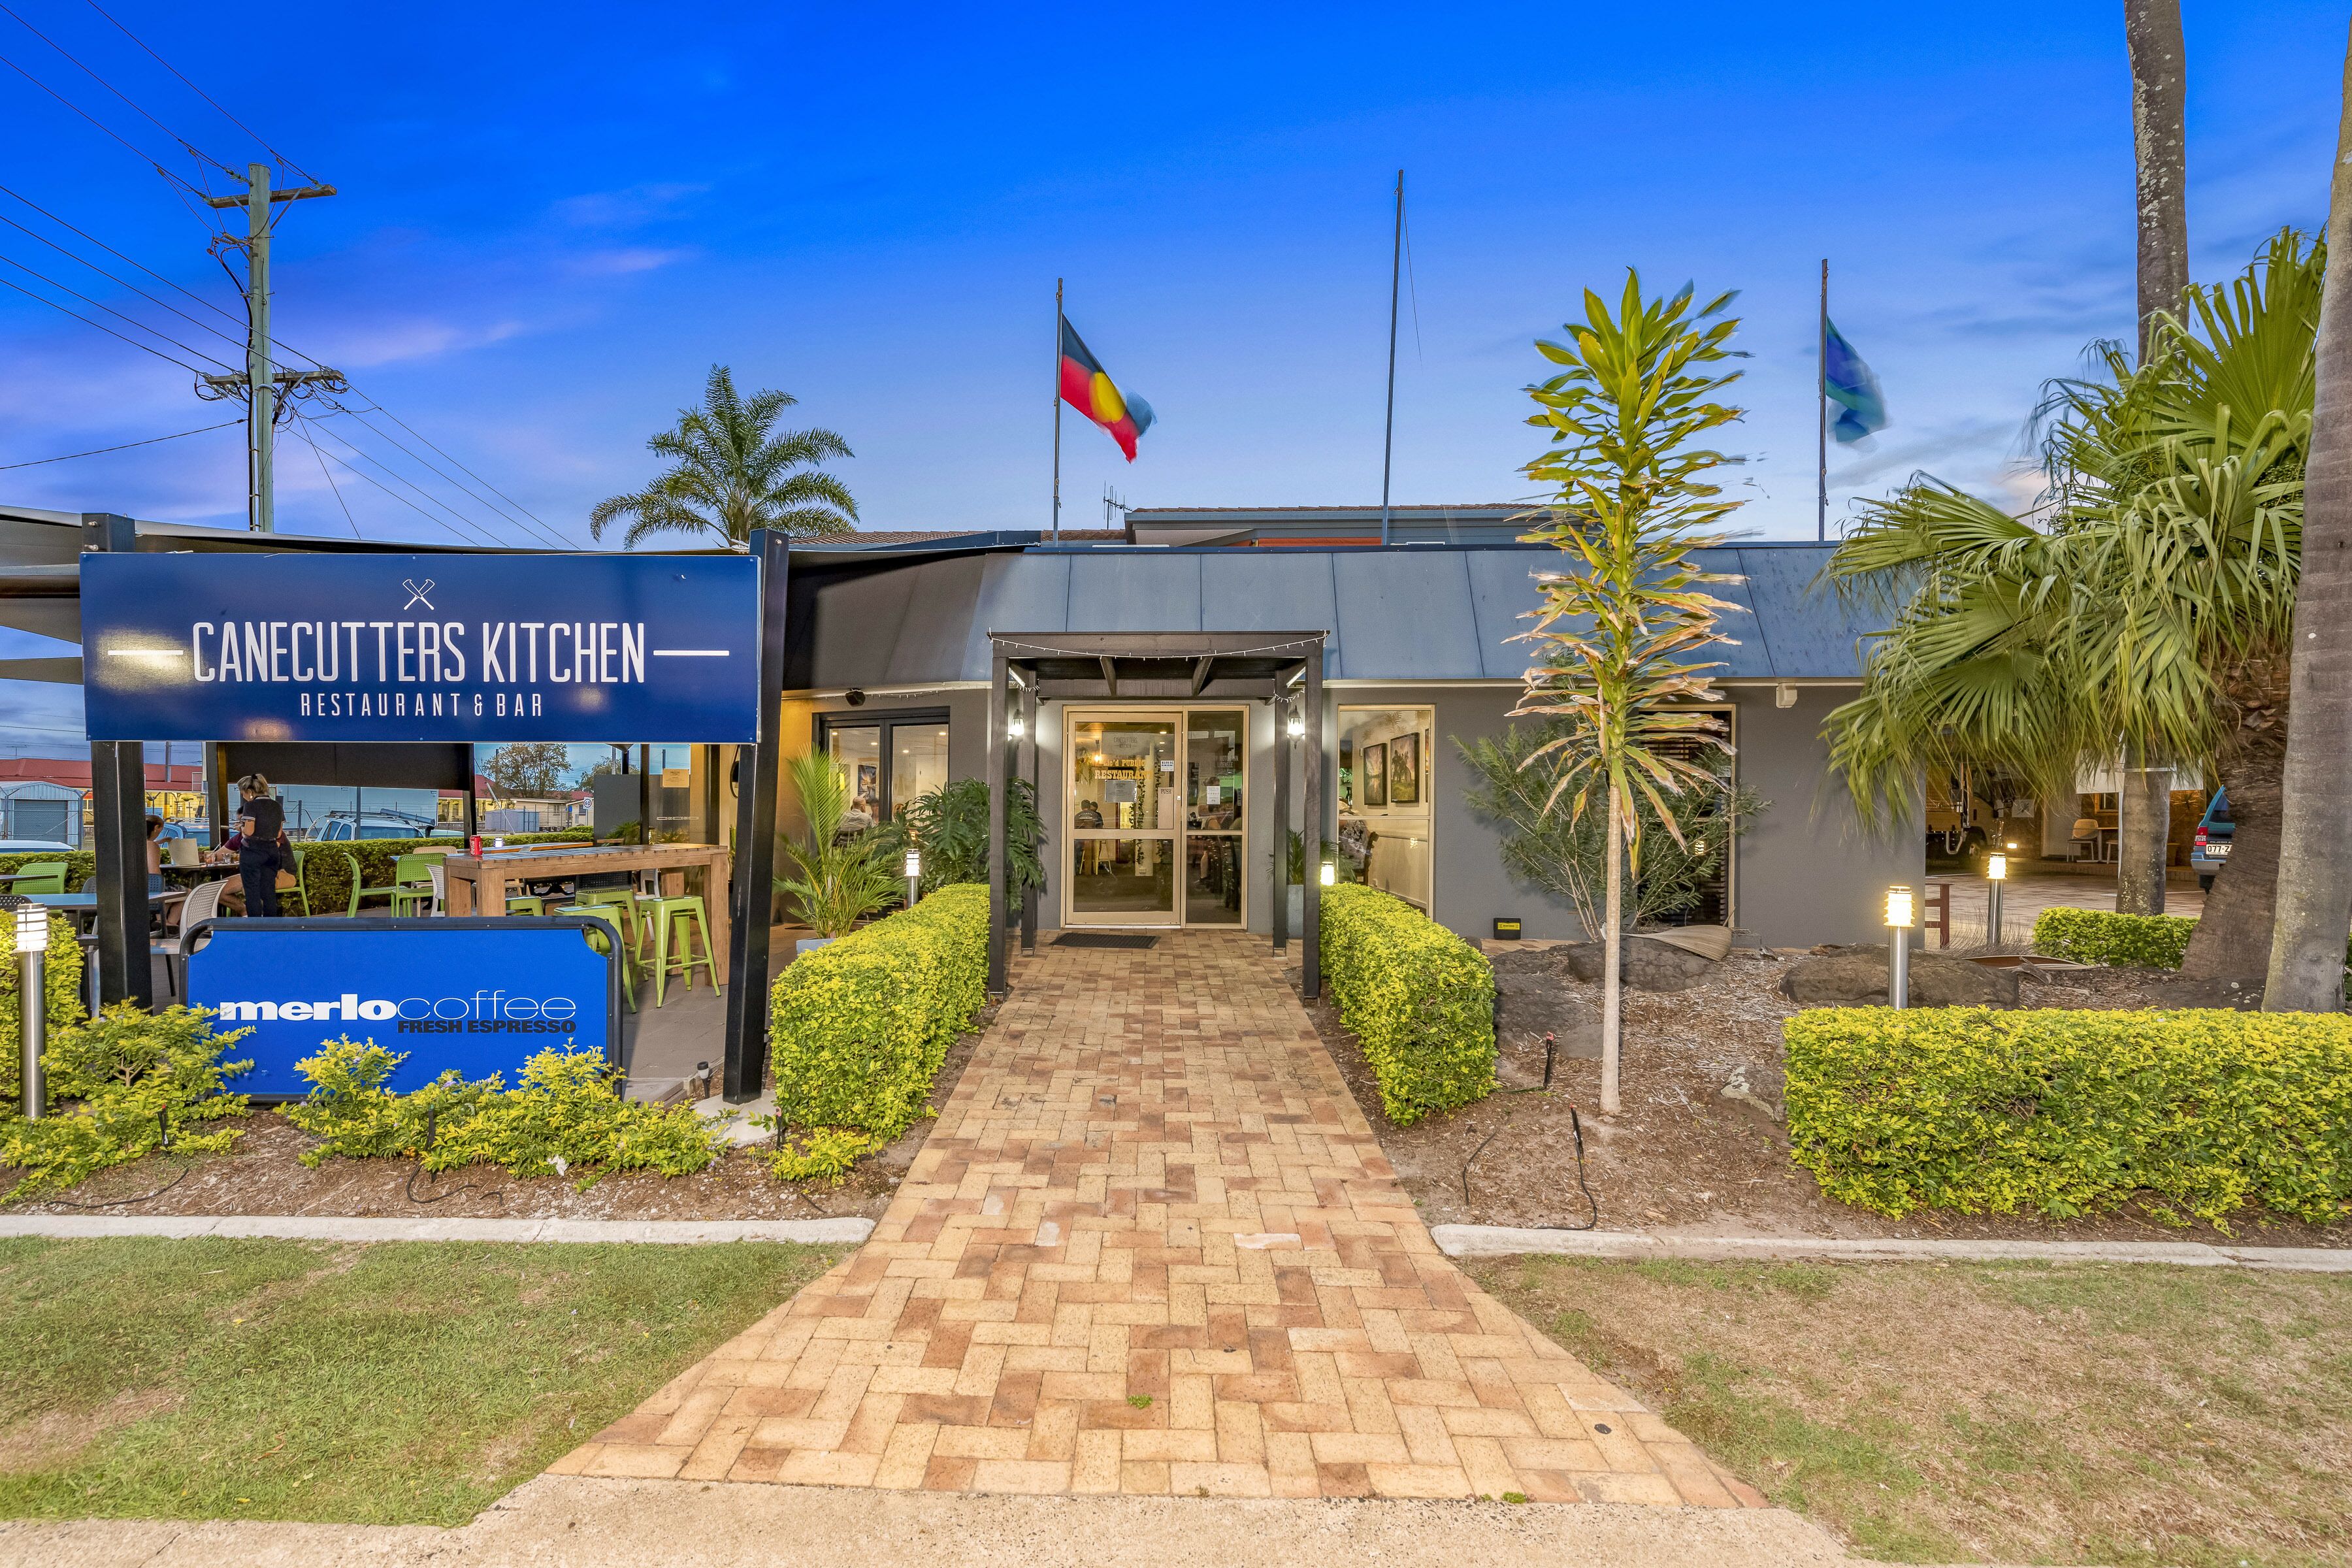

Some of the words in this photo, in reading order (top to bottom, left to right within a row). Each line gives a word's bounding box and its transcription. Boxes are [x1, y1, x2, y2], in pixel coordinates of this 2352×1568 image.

[193, 622, 465, 681] CANECUTTERS
[482, 622, 644, 683] KITCHEN
[301, 693, 461, 716] RESTAURANT
[474, 693, 483, 716] &
[497, 693, 541, 716] BAR
[397, 1020, 463, 1034] FRESH
[467, 1020, 576, 1034] ESPRESSO
